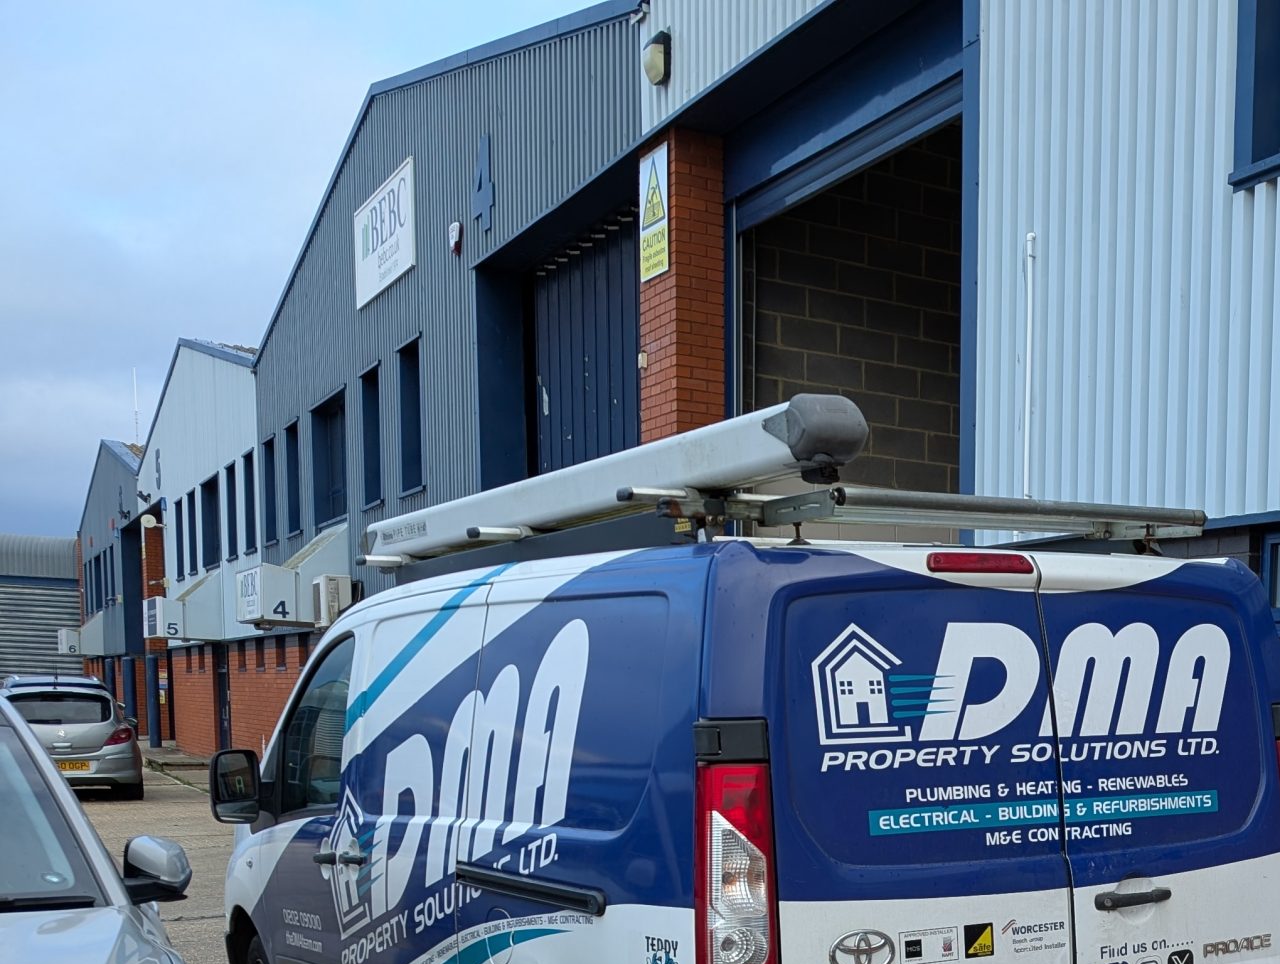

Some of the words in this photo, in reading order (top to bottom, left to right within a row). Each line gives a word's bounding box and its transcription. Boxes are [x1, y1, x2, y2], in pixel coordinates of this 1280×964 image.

[471, 132, 494, 231] 4
[370, 177, 406, 255] BEBC
[642, 228, 666, 252] CAUTION
[272, 600, 290, 619] 4
[166, 622, 179, 636] 5
[68, 644, 77, 654] 6
[918, 621, 1231, 742] DMA
[820, 745, 1000, 772] PROPERTY
[1010, 739, 1167, 764] SOLUTIONS
[1177, 737, 1220, 757] LTD.
[371, 618, 590, 920] DMA
[905, 783, 991, 803] PLUMBING
[997, 783, 1009, 797] &
[1016, 780, 1082, 796] HEATNG
[1098, 774, 1189, 791] RENEWABLES
[879, 808, 980, 830] ELECTRICAL
[998, 803, 1071, 821] BUILDING
[1076, 802, 1088, 816] &
[1093, 794, 1212, 814] REFURBISHMENTS
[985, 829, 1022, 846] M&E
[1028, 822, 1132, 844] CONTRACTING
[518, 832, 560, 875] LTD.
[1011, 921, 1065, 936] WORCESTER
[645, 936, 678, 957] TEDDY
[1100, 942, 1128, 960] Find
[1132, 941, 1148, 954] us
[1203, 933, 1272, 958] PROACE
